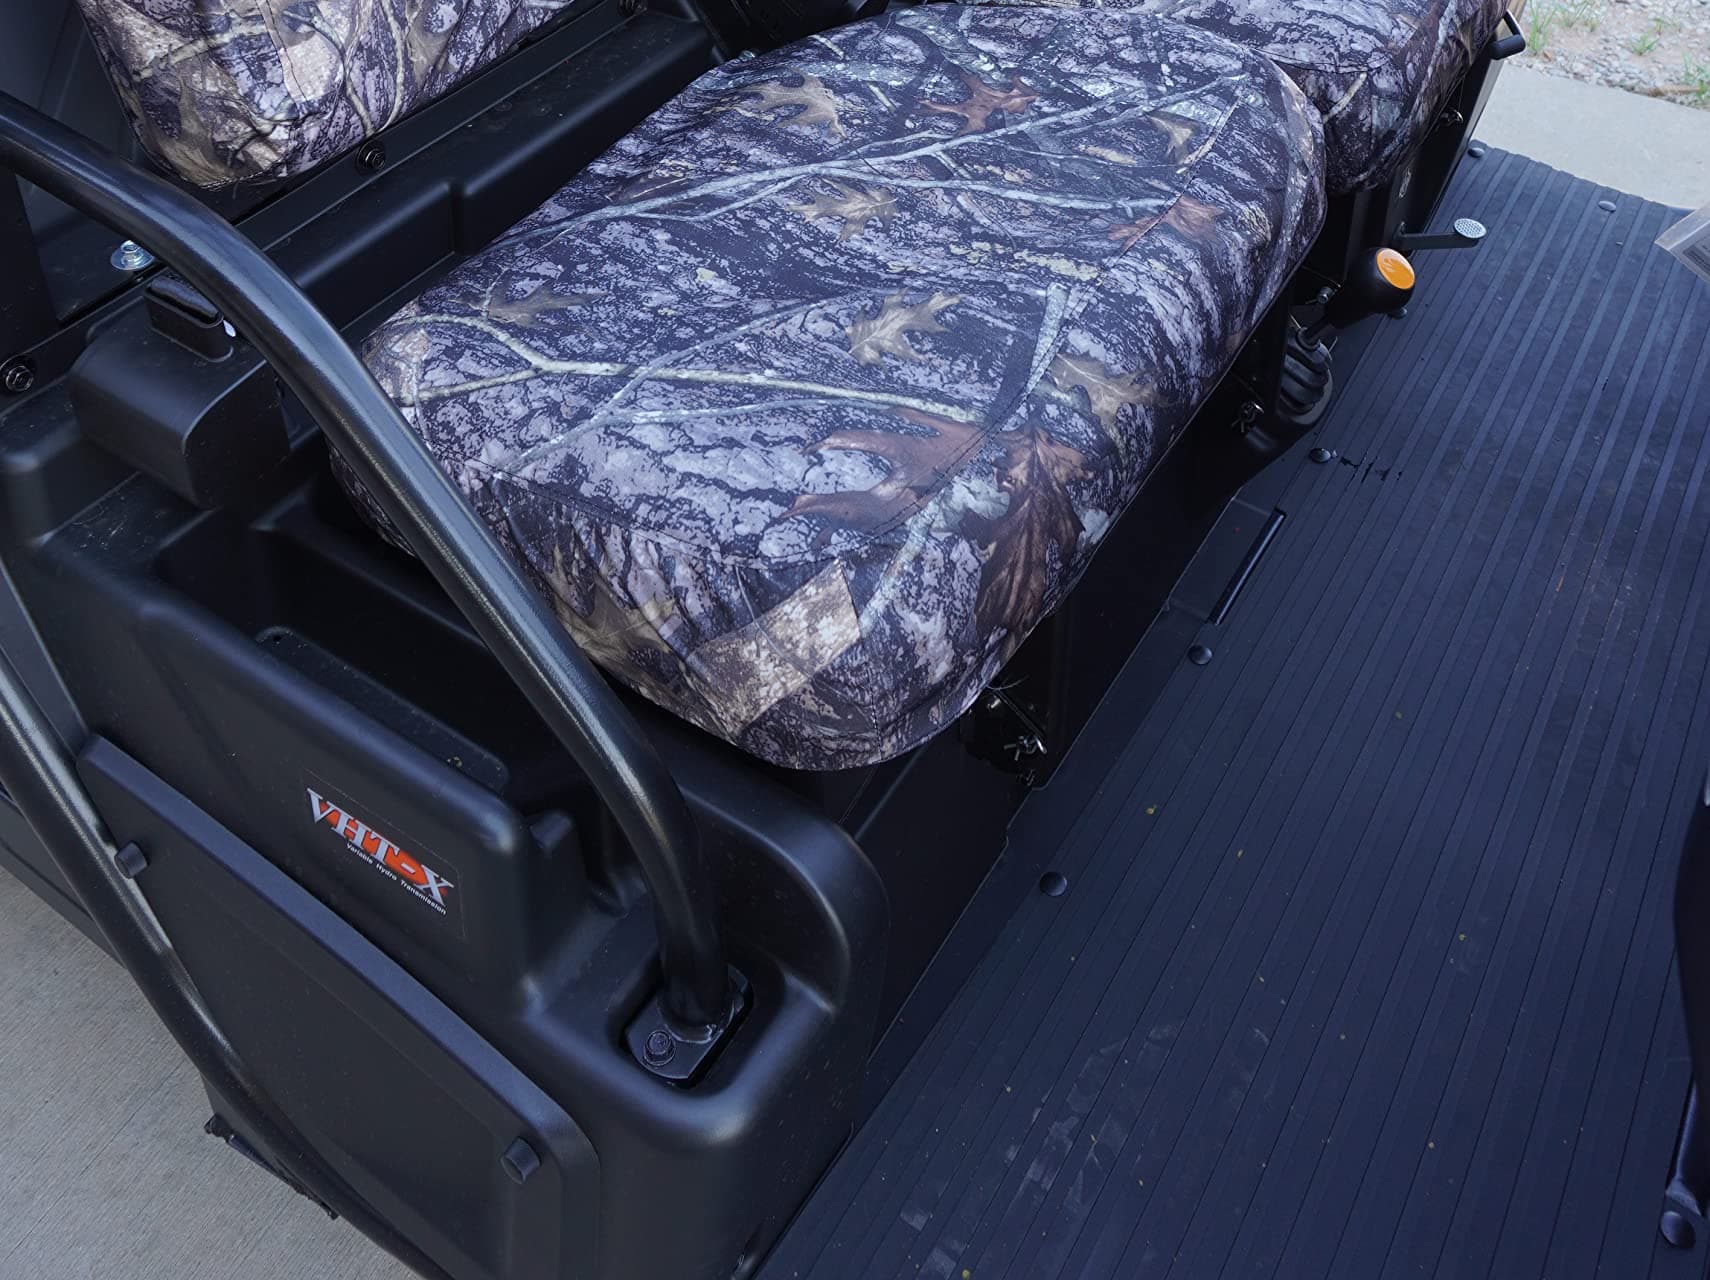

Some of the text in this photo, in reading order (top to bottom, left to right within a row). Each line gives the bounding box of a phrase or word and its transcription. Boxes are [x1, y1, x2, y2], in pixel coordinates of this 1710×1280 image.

[307, 788, 454, 906] VHT-X
[346, 843, 447, 915] Variable Hydro Transmission
